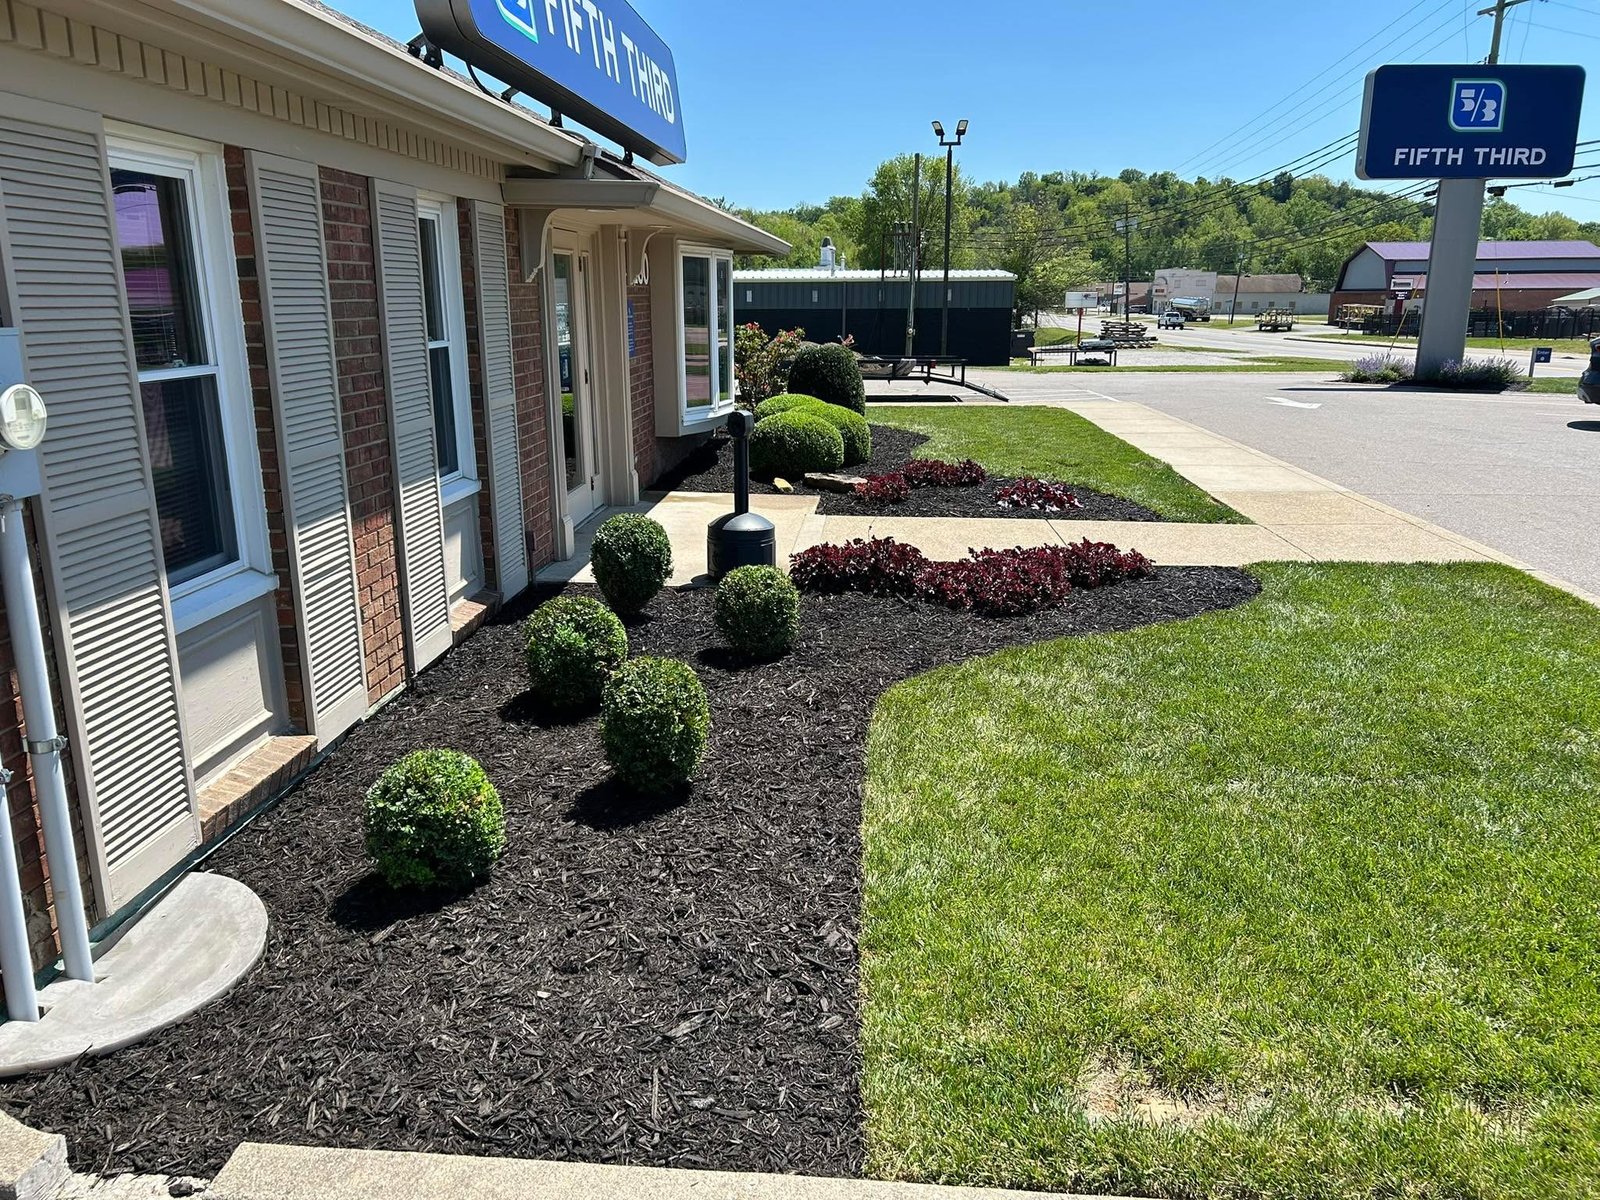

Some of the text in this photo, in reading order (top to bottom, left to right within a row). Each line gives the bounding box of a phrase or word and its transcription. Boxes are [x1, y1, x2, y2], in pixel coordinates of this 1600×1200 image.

[621, 31, 675, 125] THIRD
[1394, 147, 1547, 166] FIFTH THIRD
